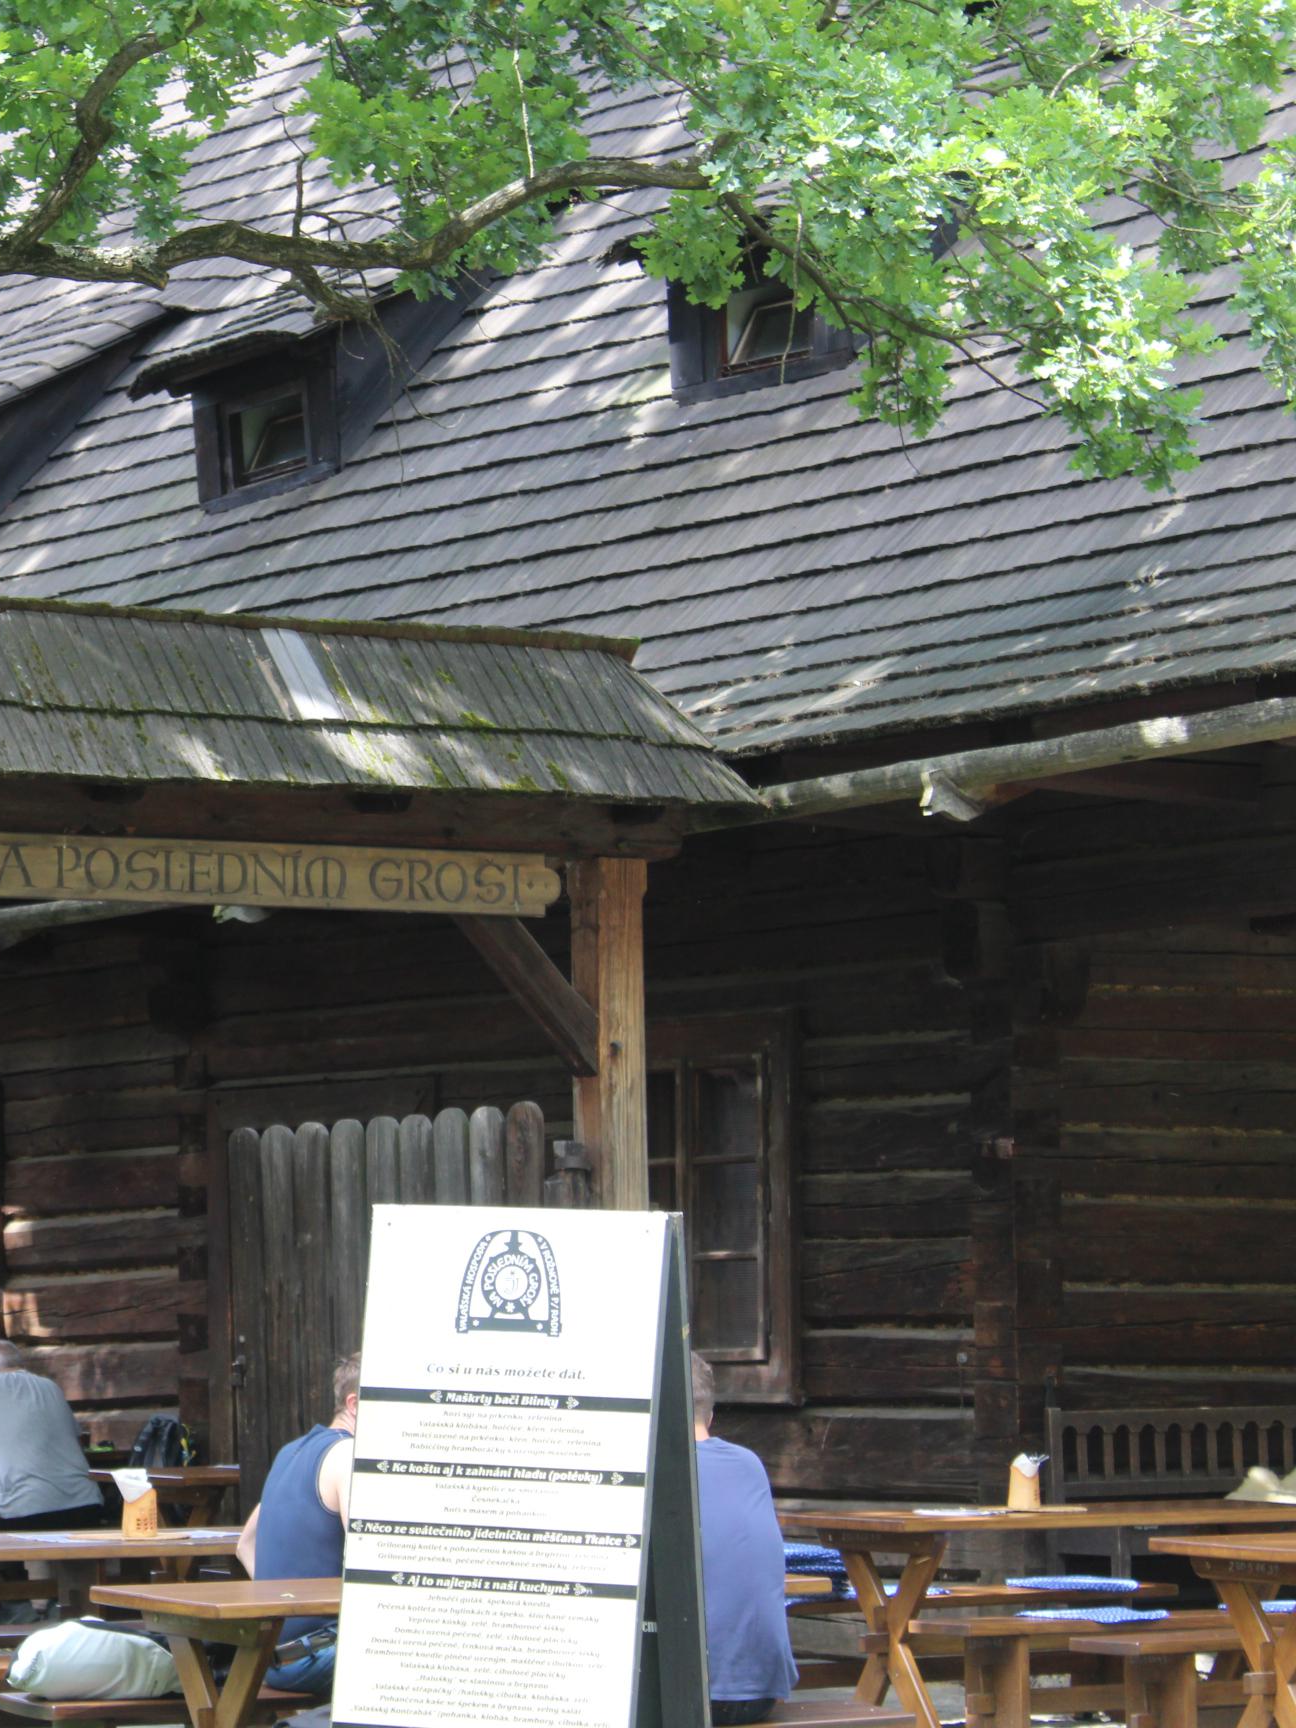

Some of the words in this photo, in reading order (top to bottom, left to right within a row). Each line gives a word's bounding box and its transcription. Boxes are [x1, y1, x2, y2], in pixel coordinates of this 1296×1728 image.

[53, 845, 347, 901] POSLEDNÍM
[368, 857, 524, 905] GROŠI
[539, 1242, 549, 1251] V
[465, 1241, 488, 1285] HOSPODA
[489, 1291, 503, 1308] NA
[426, 1362, 444, 1373] Co
[448, 1363, 460, 1374] si
[464, 1366, 472, 1374] u
[475, 1364, 500, 1376] nás
[445, 1391, 492, 1406] Maškrty
[520, 1394, 558, 1409] Blinky
[392, 1462, 406, 1472] Ke
[408, 1462, 440, 1474] koštu
[442, 1464, 454, 1477] aj
[456, 1465, 463, 1475] k
[464, 1465, 512, 1477] zahnání
[513, 1467, 546, 1479] hladu
[548, 1469, 603, 1484] (polévky)
[364, 1522, 392, 1533] Něco
[394, 1526, 408, 1534] ze
[408, 1524, 470, 1537] svátečního
[471, 1527, 530, 1542] jídelníčku
[532, 1529, 582, 1542] měšťana
[584, 1532, 622, 1544] Tkalce
[407, 1574, 420, 1588] Aj
[422, 1575, 434, 1586] to
[484, 1580, 491, 1589] z
[519, 1579, 569, 1595] kuchyně
